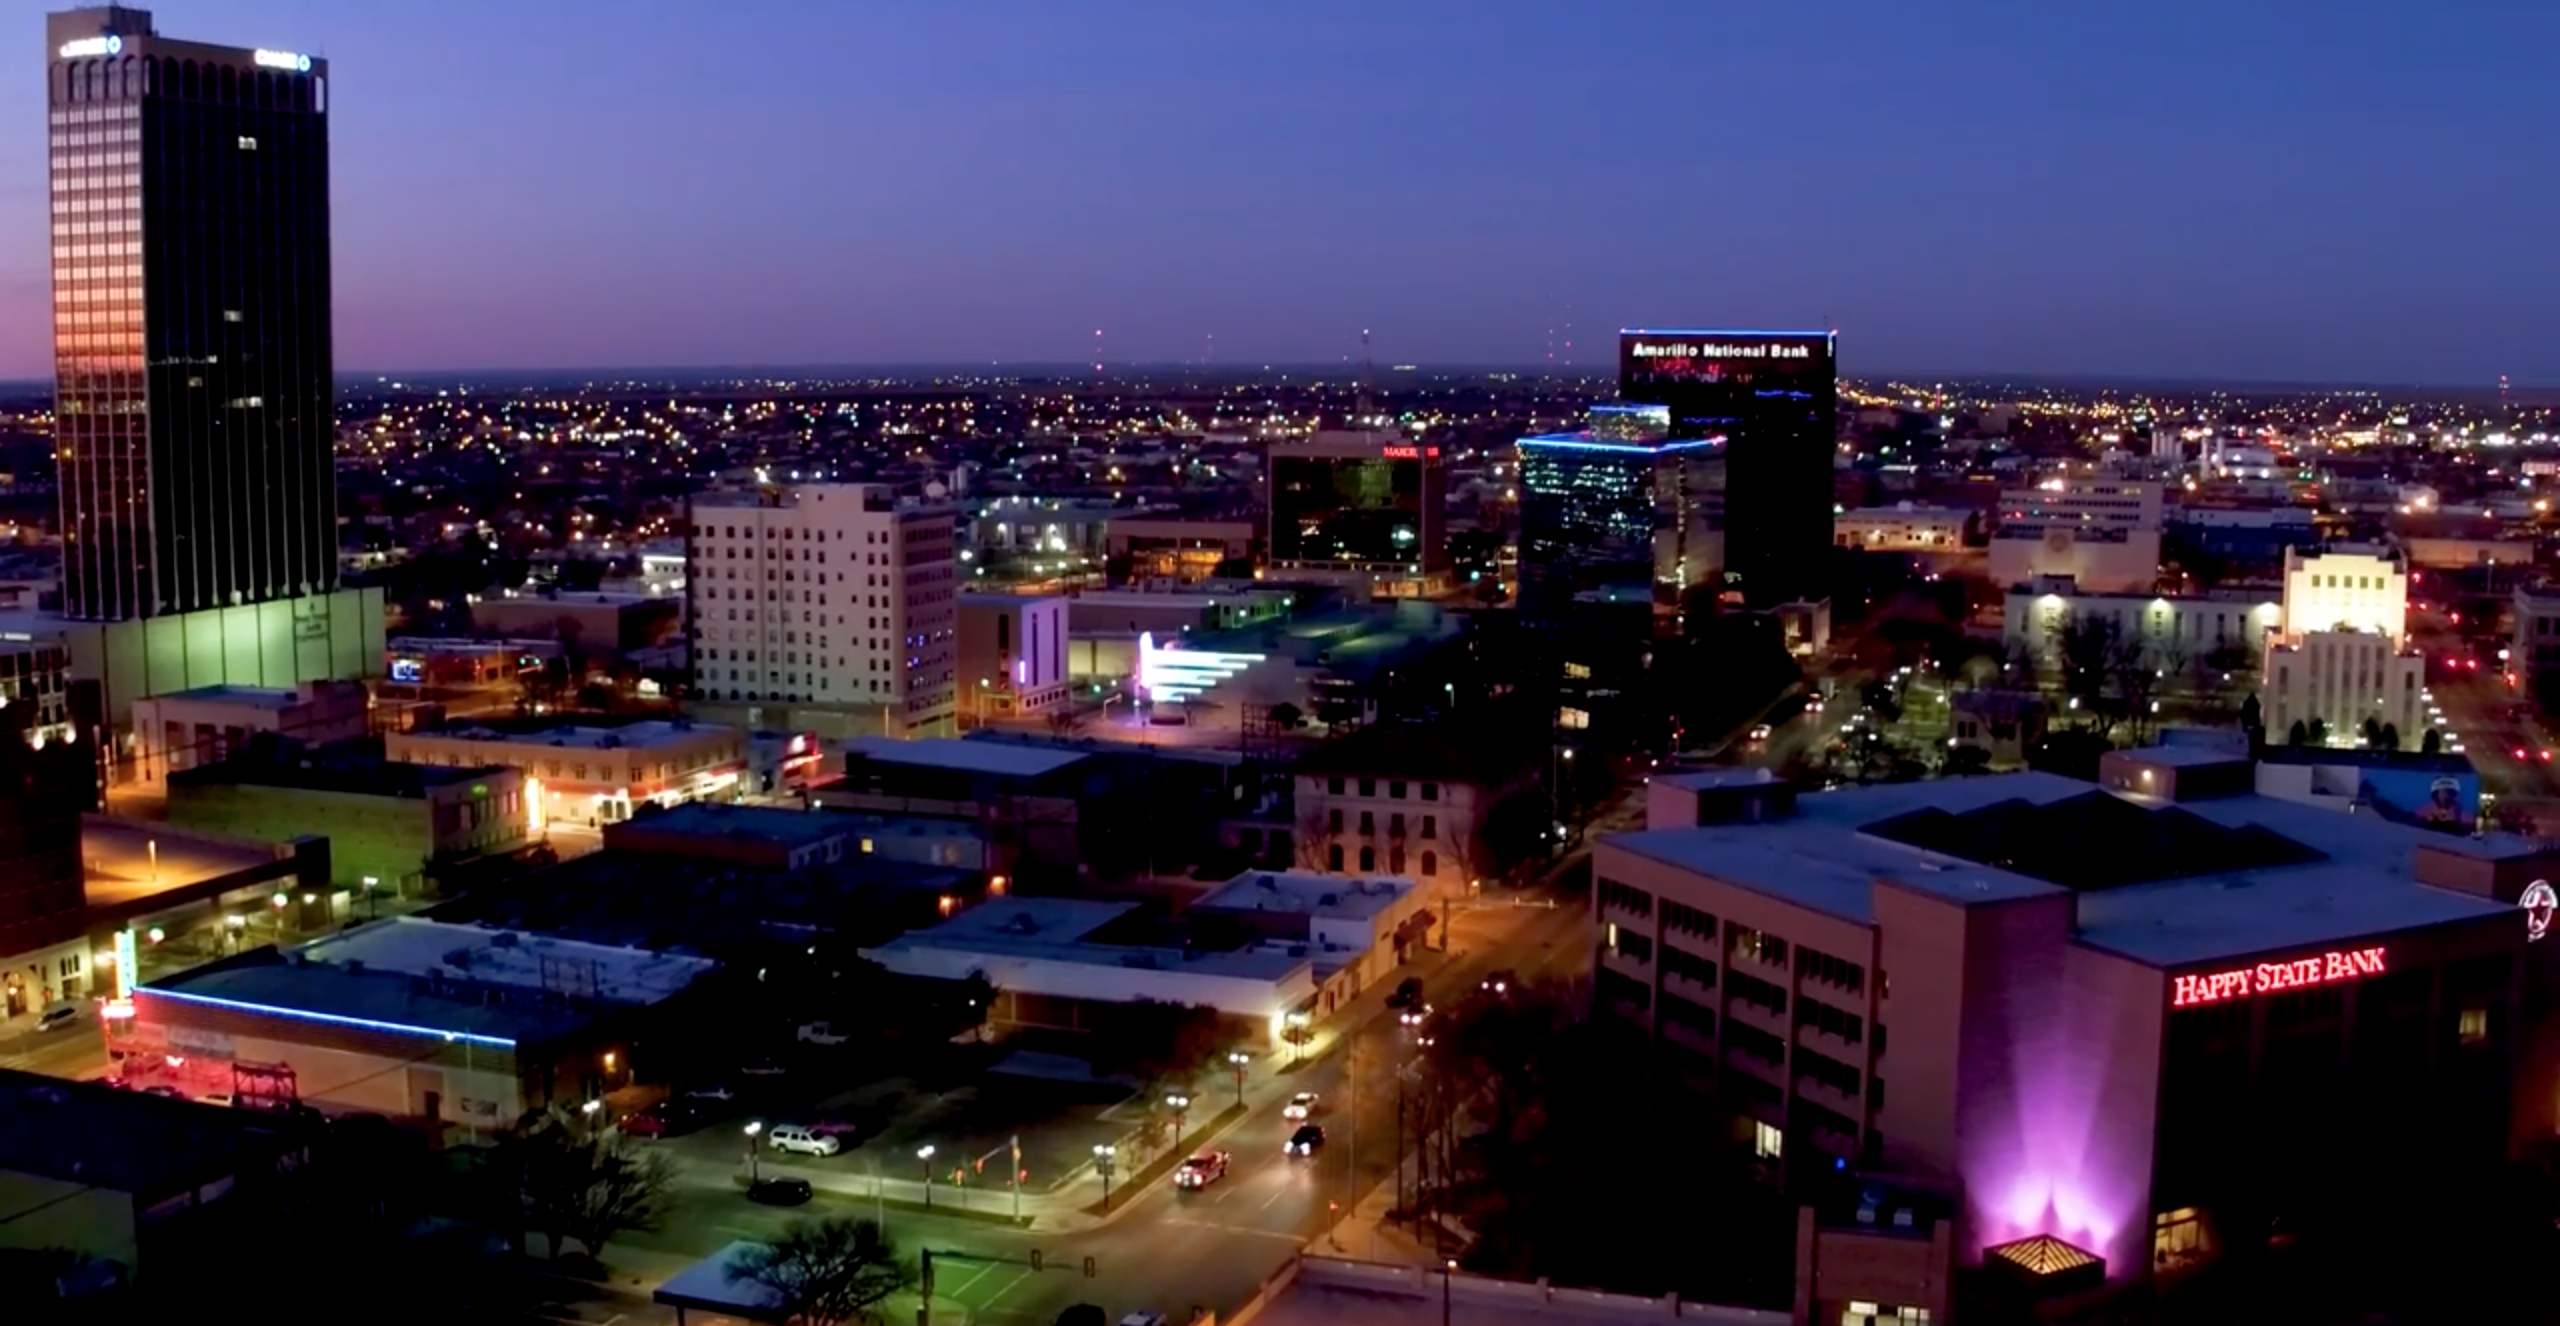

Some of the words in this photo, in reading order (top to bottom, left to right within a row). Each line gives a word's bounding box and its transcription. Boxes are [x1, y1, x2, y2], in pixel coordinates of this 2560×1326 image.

[1632, 342, 1698, 358] Amarillo
[1703, 343, 1766, 358] National
[1770, 344, 1809, 358] Bank
[2173, 968, 2253, 1005] HAPPY
[2255, 957, 2321, 992] STATE
[2324, 947, 2386, 980] BANK
